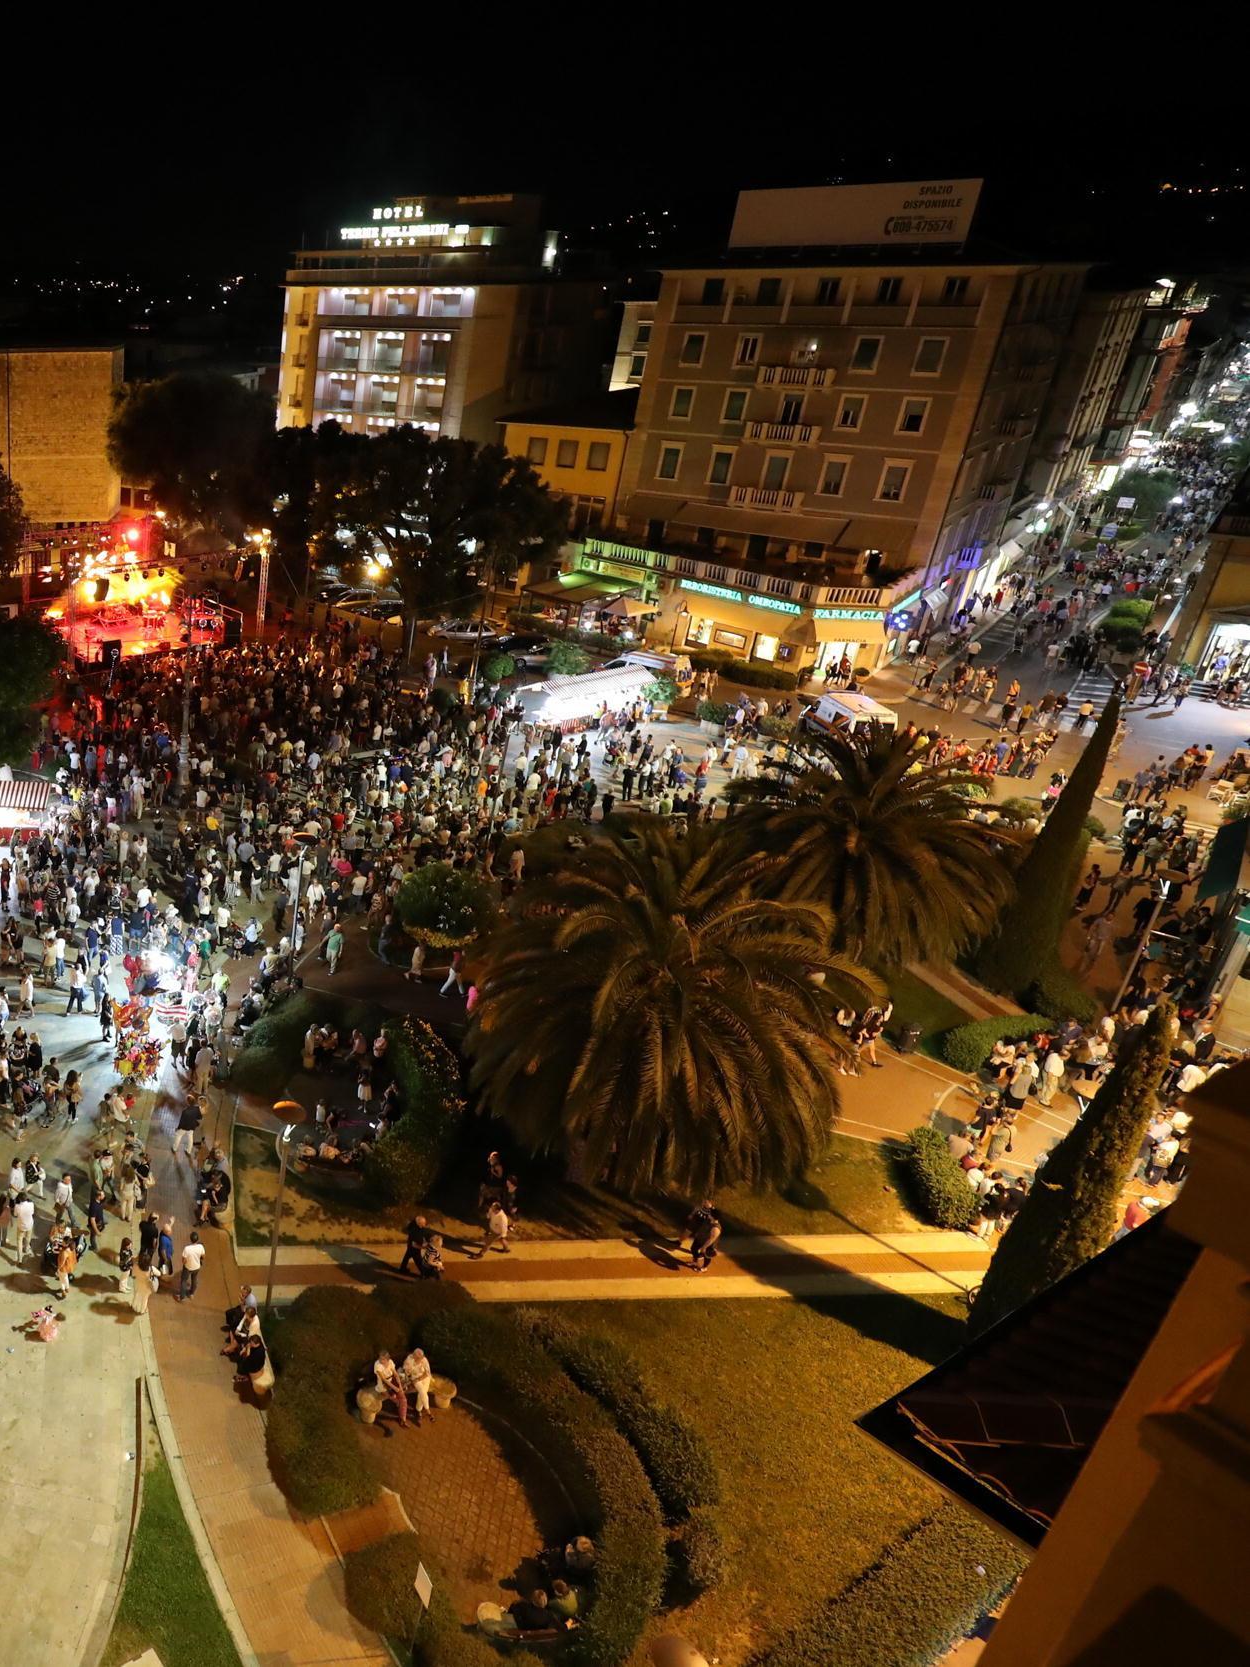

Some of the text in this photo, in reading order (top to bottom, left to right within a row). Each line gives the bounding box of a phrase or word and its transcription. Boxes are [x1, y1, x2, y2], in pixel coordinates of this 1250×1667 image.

[919, 185, 953, 195] SPAZIO
[903, 198, 962, 209] DISPONIBILE
[373, 205, 423, 220] HOTEL
[680, 579, 802, 615] ERBORISTERIA OMEOPATIA
[814, 609, 884, 620] FARMACIA
